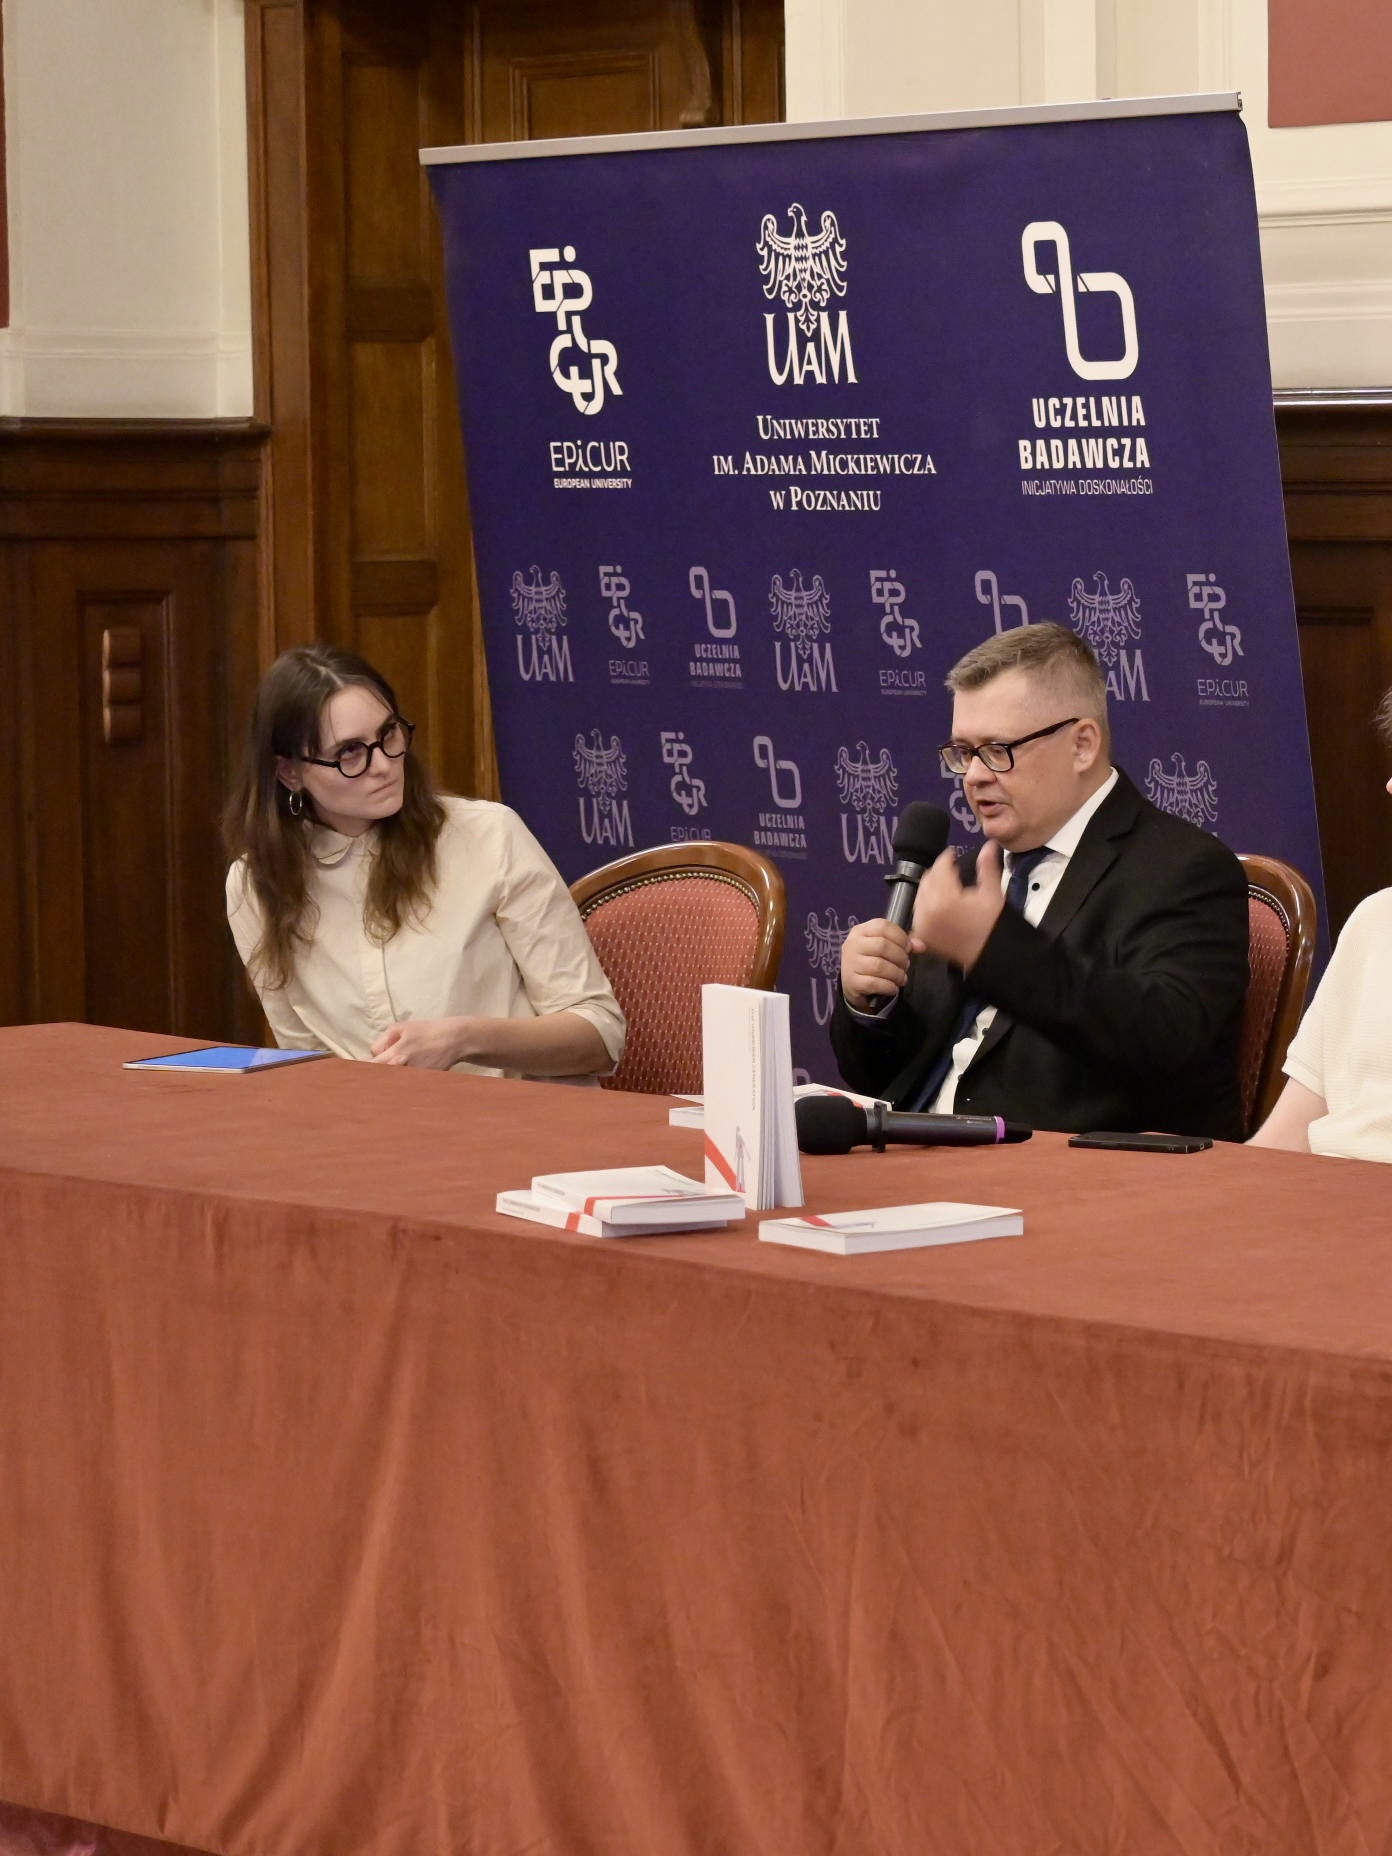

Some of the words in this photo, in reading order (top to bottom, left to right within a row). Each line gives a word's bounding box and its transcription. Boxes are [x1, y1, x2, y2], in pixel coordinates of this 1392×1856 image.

[1032, 395, 1146, 428] UCZELNIA
[1018, 437, 1150, 470] BADAWCZA
[553, 478, 590, 489] EUROPEAN
[591, 478, 632, 489] UNIVERSITY
[1021, 479, 1077, 496] INICJATYWA
[1079, 475, 1153, 496] DOSKONAŁOŚCI
[694, 643, 740, 659] UCZELNIA
[689, 661, 742, 678] BADAWCZA
[1093, 649, 1151, 701] AM
[758, 812, 805, 830] UCZELNIA
[753, 830, 807, 848] BADAWCZA
